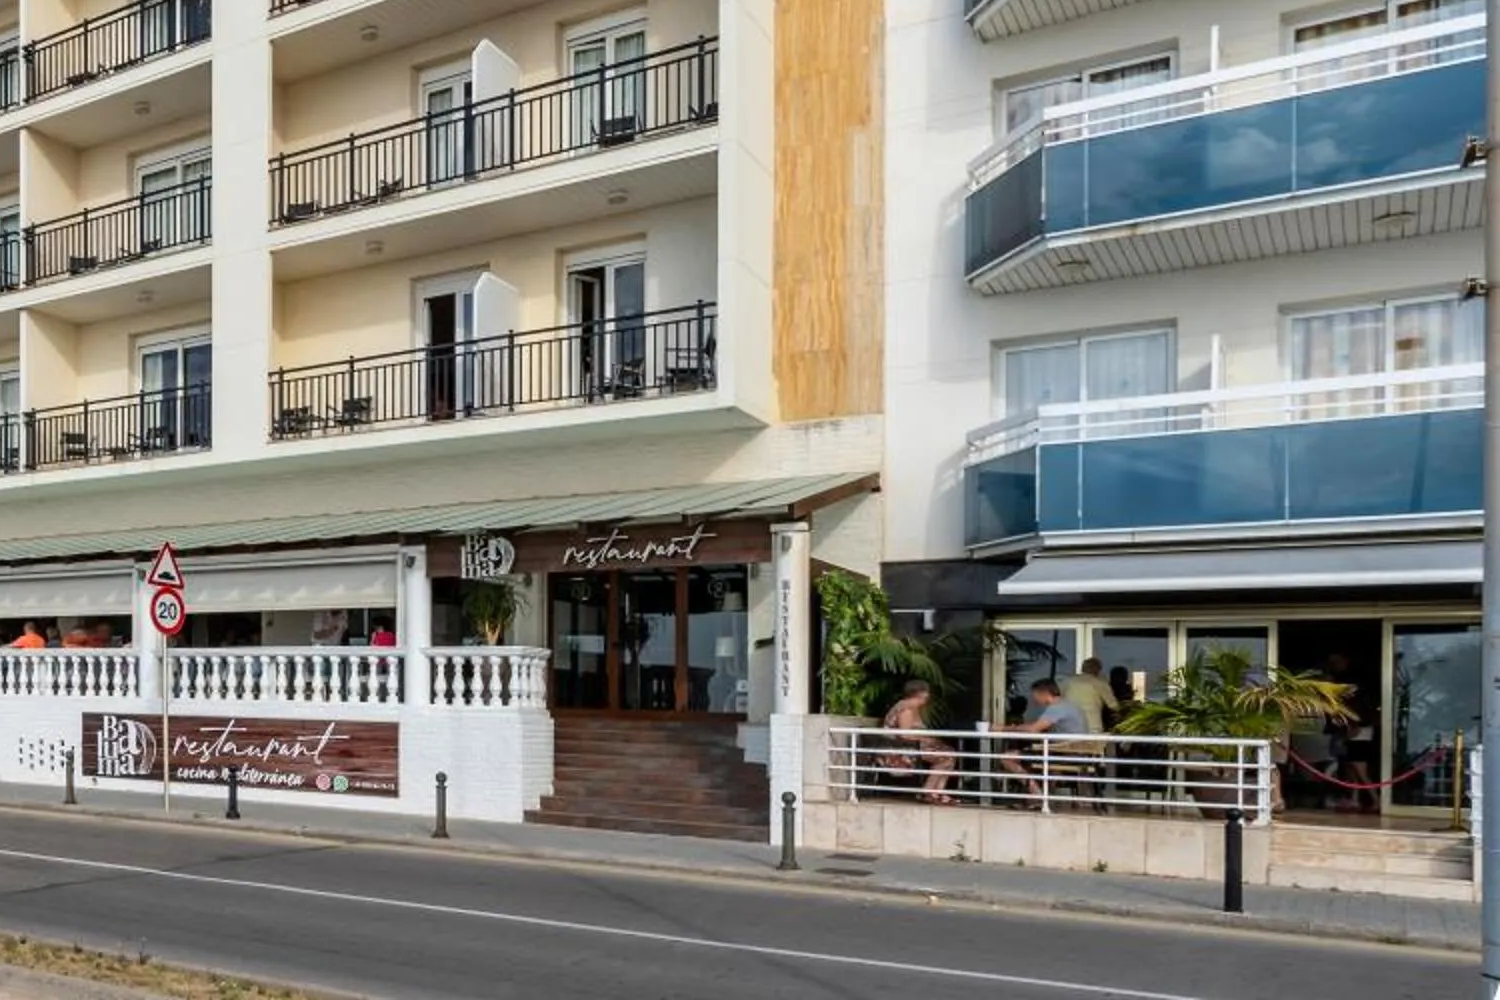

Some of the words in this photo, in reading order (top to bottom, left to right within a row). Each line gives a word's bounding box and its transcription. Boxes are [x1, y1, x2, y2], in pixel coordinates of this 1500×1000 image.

[563, 524, 718, 569] restaurant
[158, 601, 177, 620] 20
[172, 718, 350, 765] restaurant
